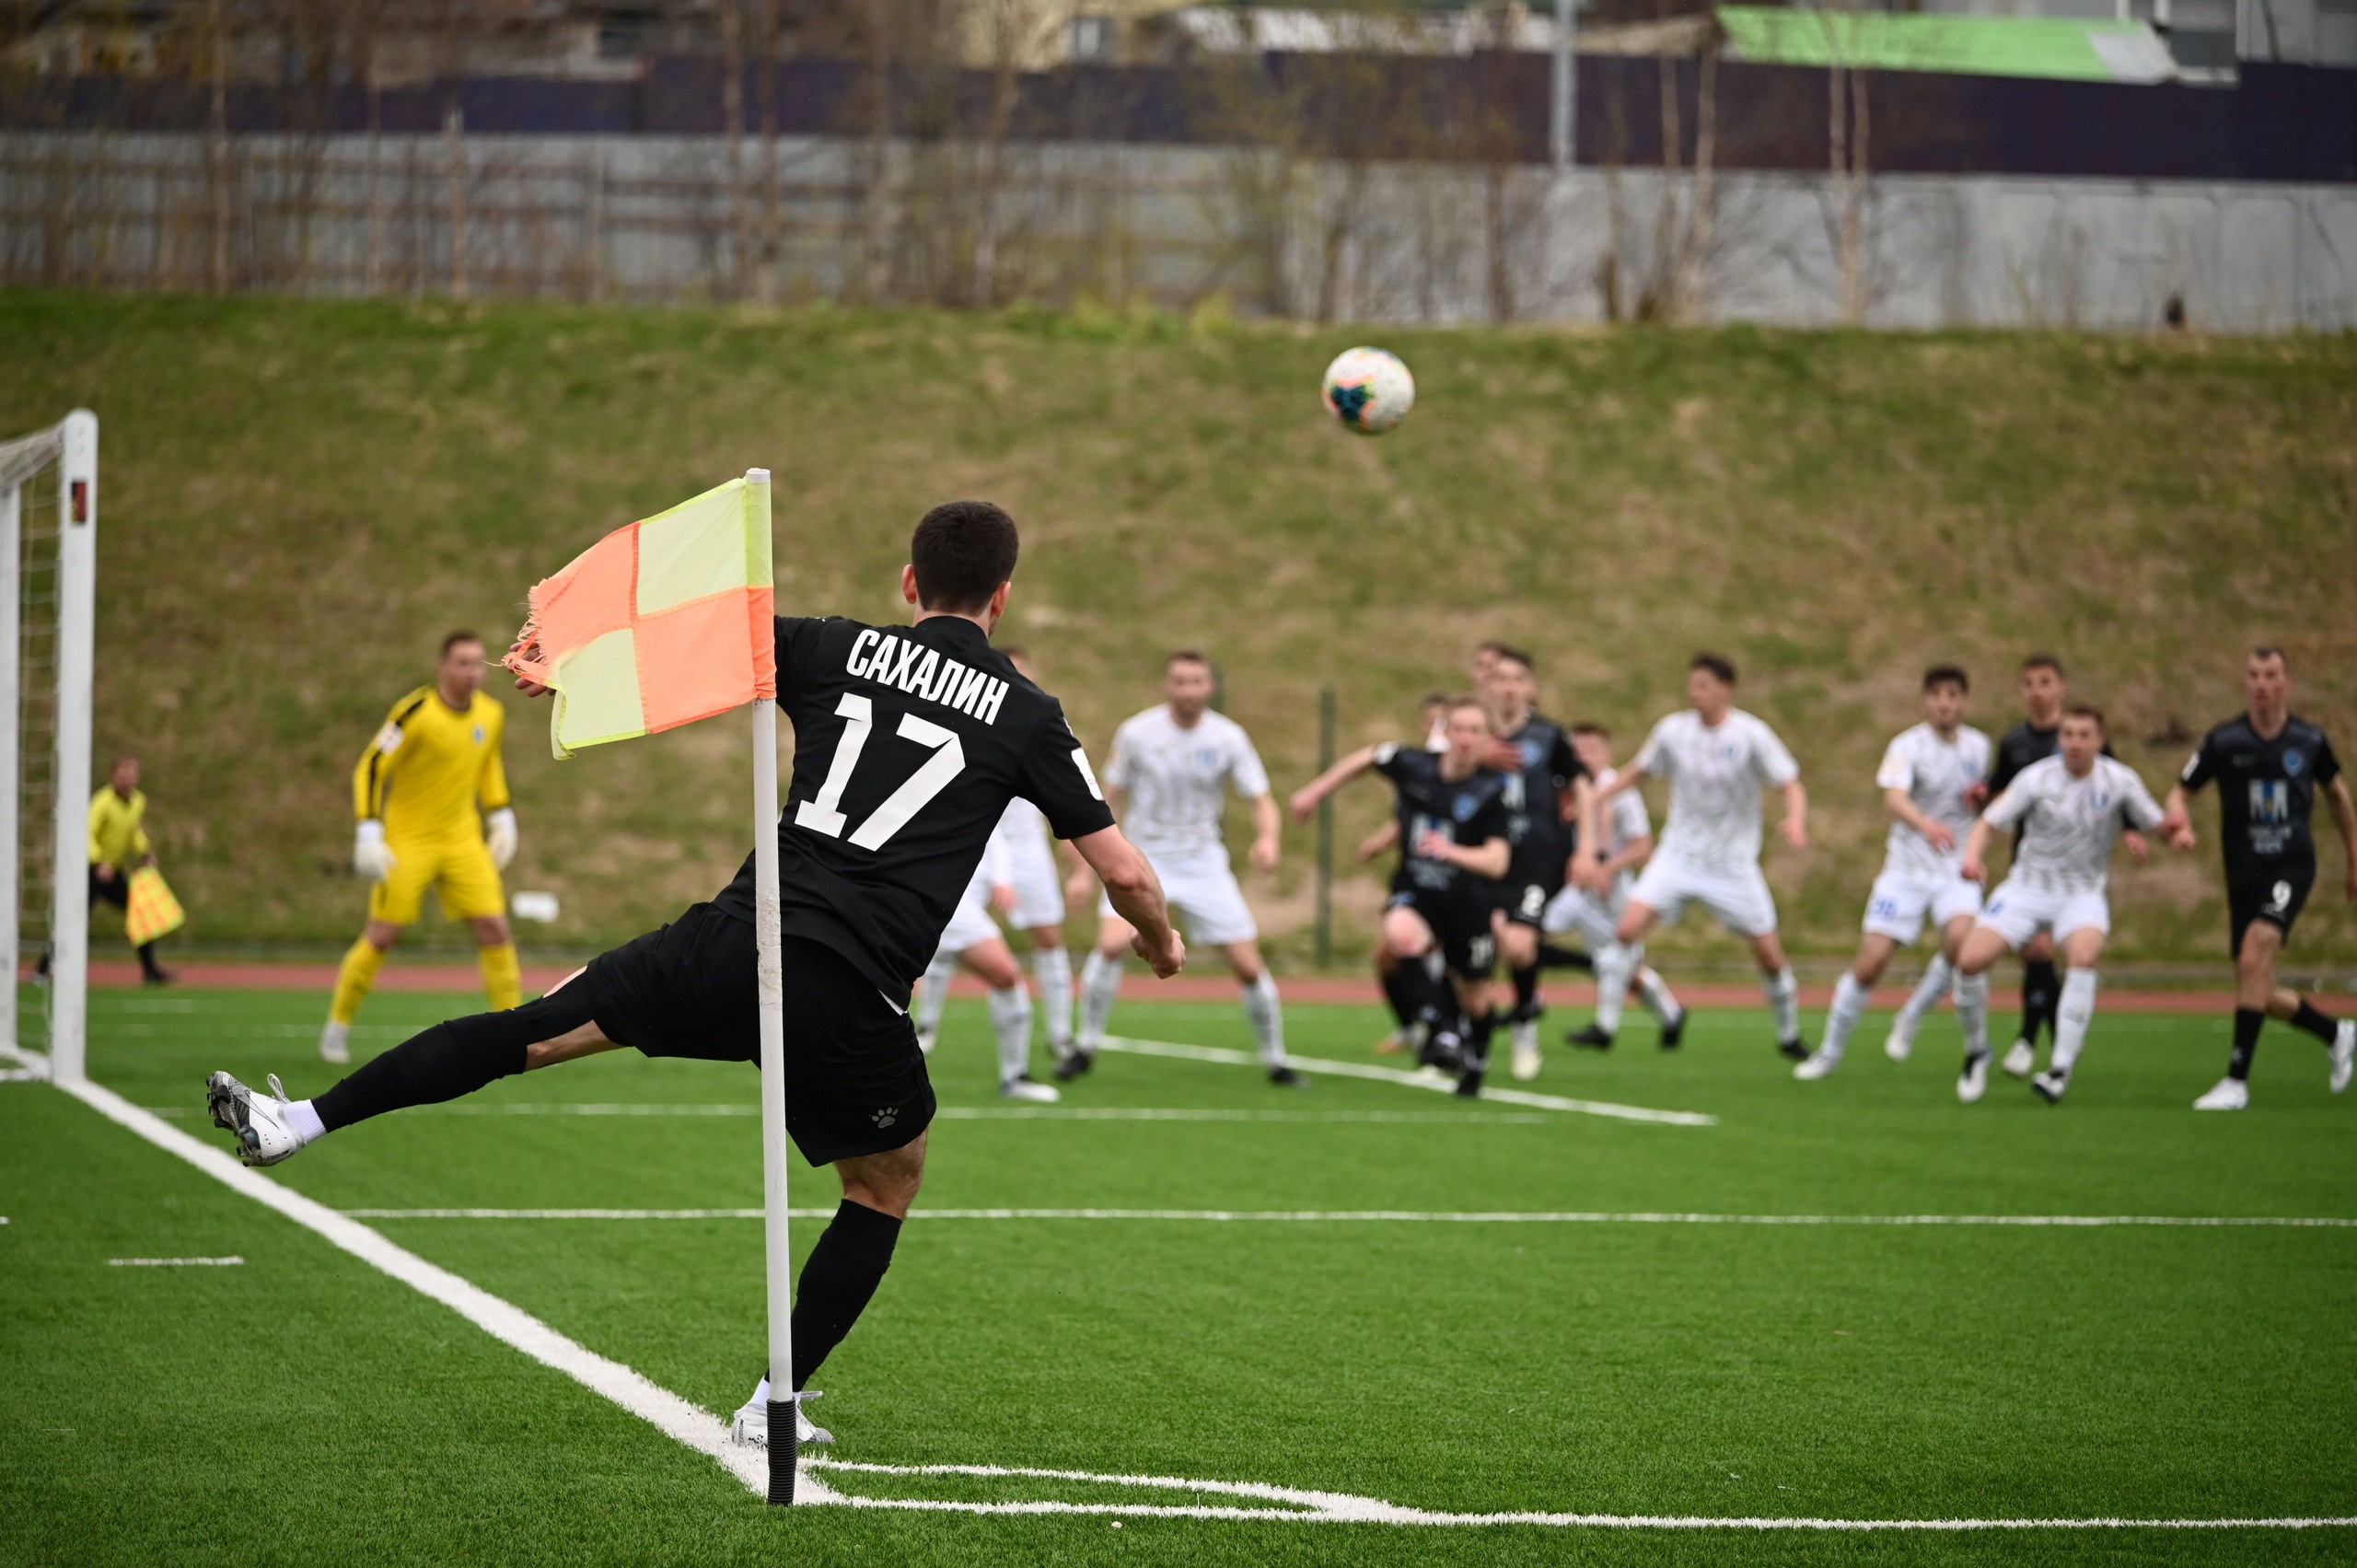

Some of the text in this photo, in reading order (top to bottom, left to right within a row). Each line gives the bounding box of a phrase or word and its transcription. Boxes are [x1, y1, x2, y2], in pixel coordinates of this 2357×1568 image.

[845, 628, 1010, 726] САХАЛИН
[794, 691, 967, 852] 17
[2272, 880, 2292, 912] 9
